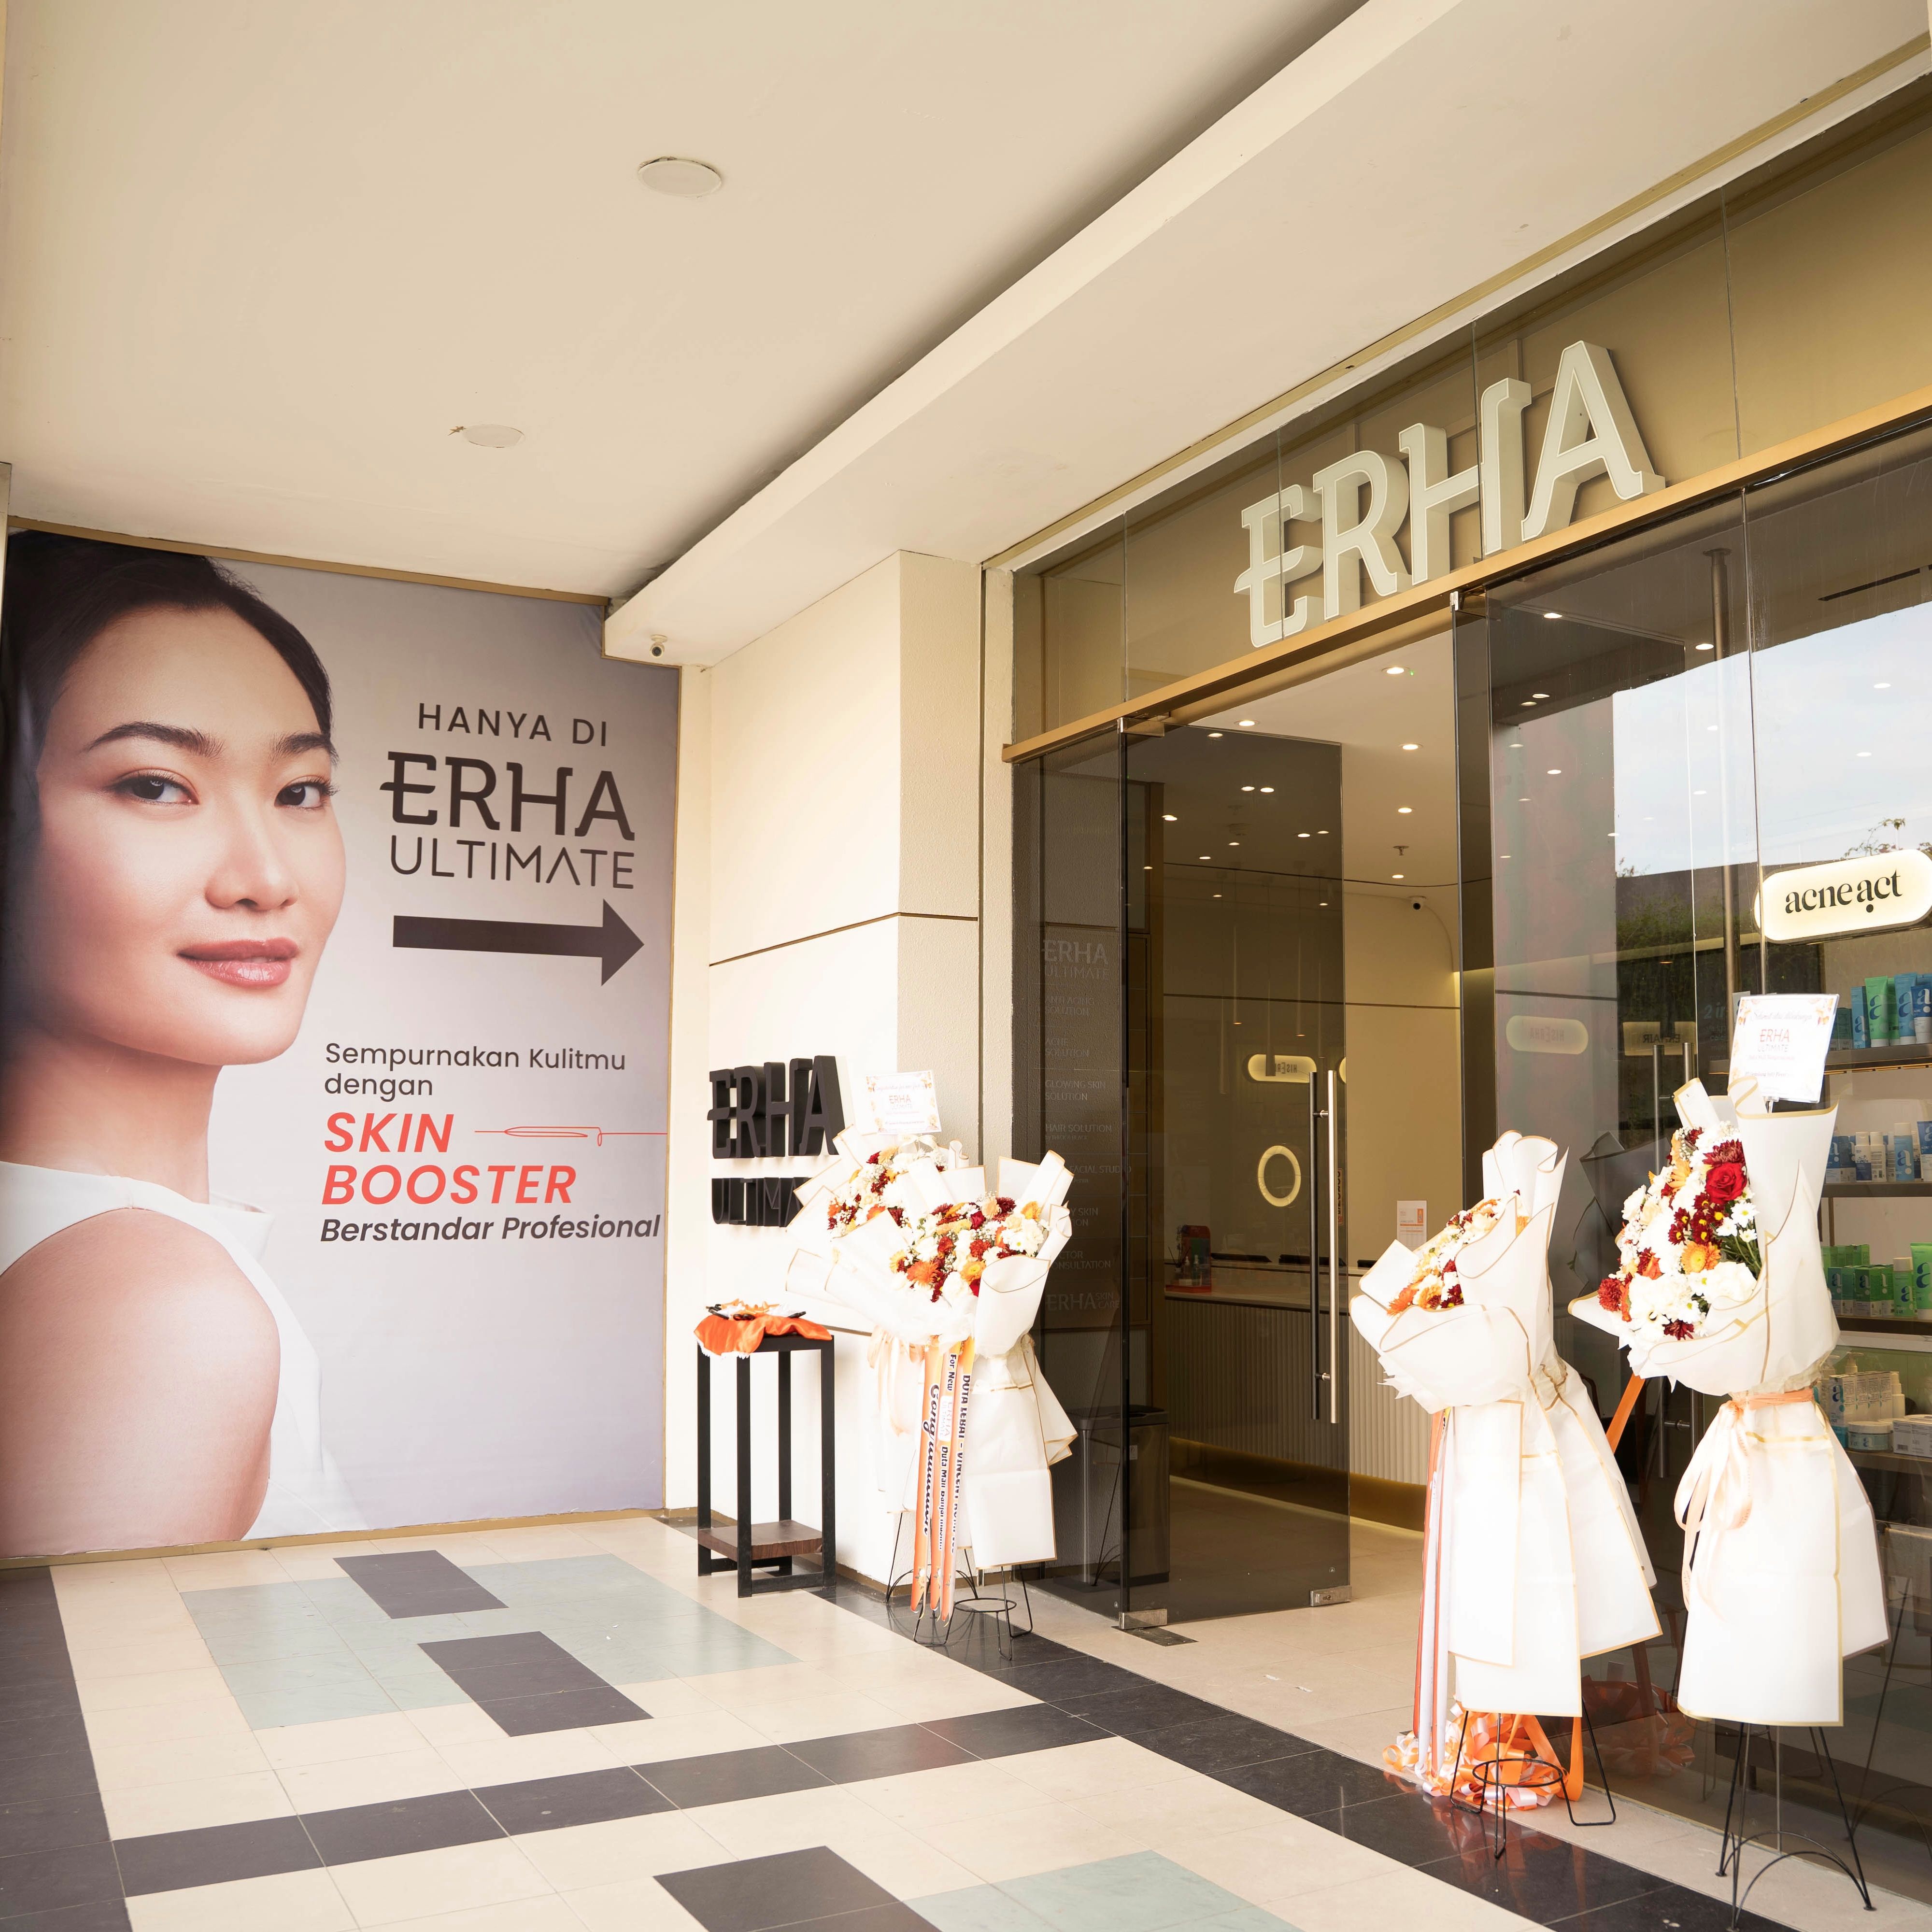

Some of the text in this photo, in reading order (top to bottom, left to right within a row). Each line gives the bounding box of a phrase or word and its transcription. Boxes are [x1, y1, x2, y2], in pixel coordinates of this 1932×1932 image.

[1235, 340, 1665, 648] ERHA
[418, 703, 607, 747] HANYA DI
[380, 751, 635, 841] ERHA
[390, 835, 634, 889] ULTIMATE
[1042, 939, 1108, 965] ERHA
[1045, 966, 1109, 981] ULTIMATE
[1760, 1028, 1790, 1043] ERHA
[325, 1043, 625, 1071] Sempurnakan Kulitmu
[1045, 1048, 1089, 1057] SOLUTION
[324, 1073, 433, 1102] dengan
[1045, 1080, 1106, 1090] GLOWING SKIN
[1045, 1092, 1088, 1101] SOLUTION
[707, 1055, 845, 1159] ERHA
[324, 1112, 454, 1153] SKIN
[1045, 1123, 1112, 1133] HAIR SOLUTION
[1070, 1165, 1132, 1174] FACIAL STUDO
[322, 1164, 576, 1205] BOOSTER
[711, 1177, 812, 1228] ULTIMA
[1078, 1208, 1099, 1216] SKIN
[320, 1214, 661, 1242] Berstandar Profesional
[1052, 1260, 1111, 1270] ONSULTATION
[1059, 1250, 1083, 1259] CTOR
[1045, 1292, 1113, 1310] ERHA SKIN
[961, 1375, 970, 1404] DUTA
